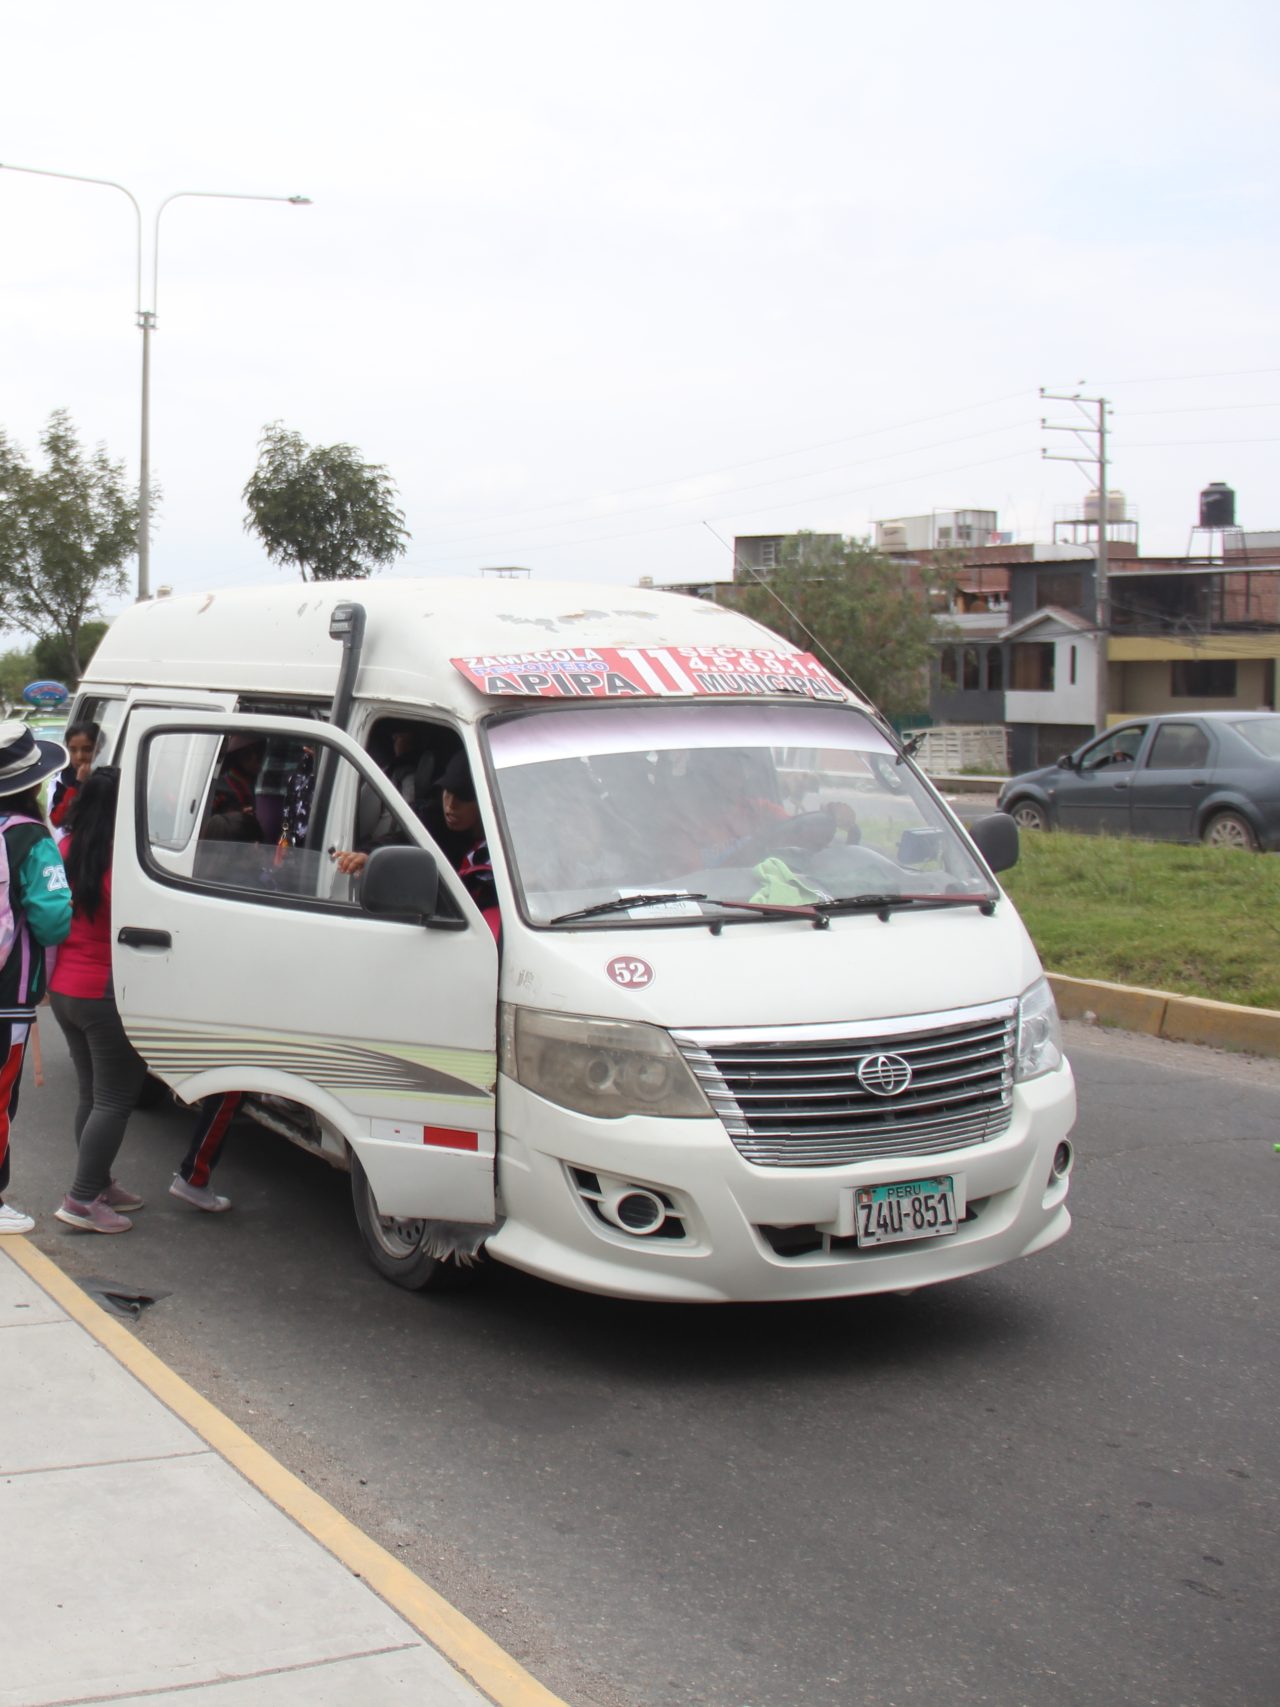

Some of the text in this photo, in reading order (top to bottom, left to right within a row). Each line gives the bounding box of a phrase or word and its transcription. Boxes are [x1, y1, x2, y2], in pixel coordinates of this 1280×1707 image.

[462, 649, 604, 668] ZAMACOLA
[470, 661, 609, 677] PESQUERO
[617, 648, 698, 695] 11
[485, 672, 646, 696] APIPA
[693, 672, 847, 699] MUNICIPAL
[614, 962, 648, 984] 52
[887, 1184, 921, 1199] PERU
[860, 1193, 953, 1238] Z4U-851
